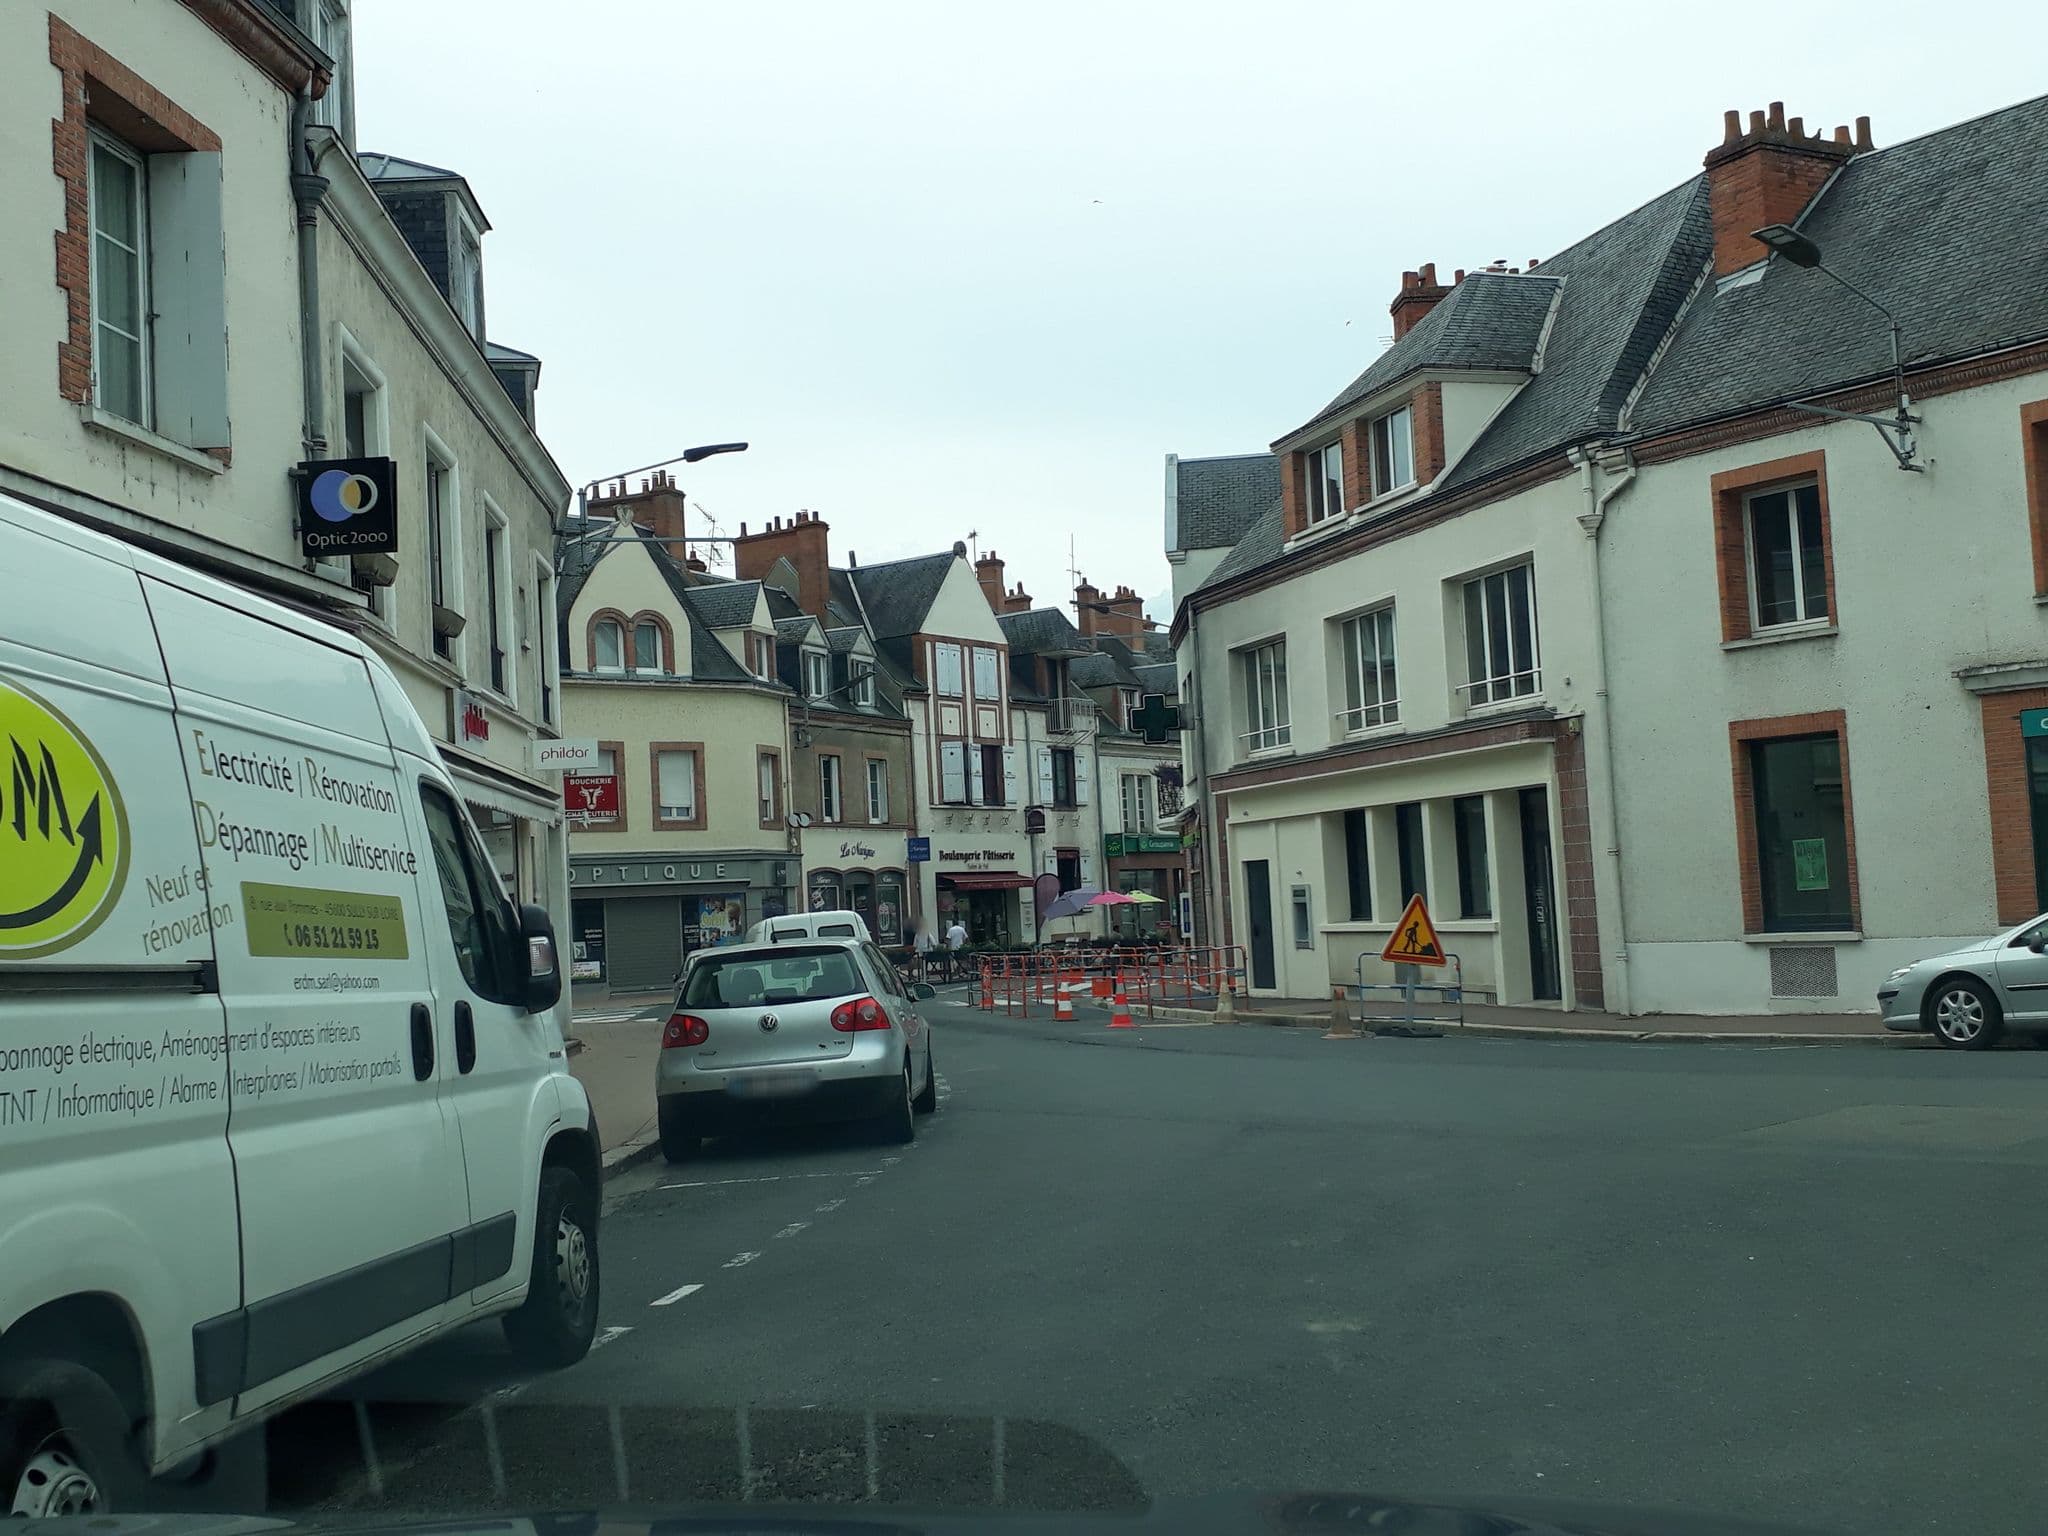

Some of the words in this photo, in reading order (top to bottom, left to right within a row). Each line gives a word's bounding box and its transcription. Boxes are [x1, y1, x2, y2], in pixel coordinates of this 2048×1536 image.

[307, 531, 348, 549] Optic
[350, 531, 388, 544] 2000
[541, 747, 589, 763] phildar
[193, 730, 294, 792] Electricité
[304, 757, 396, 814] Rénovation
[569, 777, 612, 786] BOUCHERIE
[194, 800, 309, 871] Dépannage
[321, 823, 417, 875] Multiservice
[939, 850, 981, 863] Boulangerie
[983, 849, 1015, 860] Pâtisserie
[145, 865, 190, 907] Neuf
[194, 866, 213, 891] et
[142, 903, 233, 956] rénovaton
[295, 925, 311, 948] 06
[314, 926, 329, 949] 51
[331, 927, 347, 949] 21
[349, 928, 363, 950] 59
[366, 929, 379, 950] 15
[294, 973, 379, 993] erdm.sarl@yahoo.com
[80, 1031, 156, 1068] électrique,
[160, 1028, 257, 1061] Aménagement
[317, 1020, 360, 1043] intérieurs
[58, 1083, 154, 1118] Informatique
[170, 1074, 217, 1104] Alarme
[232, 1065, 297, 1100] Interphones
[309, 1059, 367, 1085] Motorisation
[370, 1052, 401, 1084] portails
